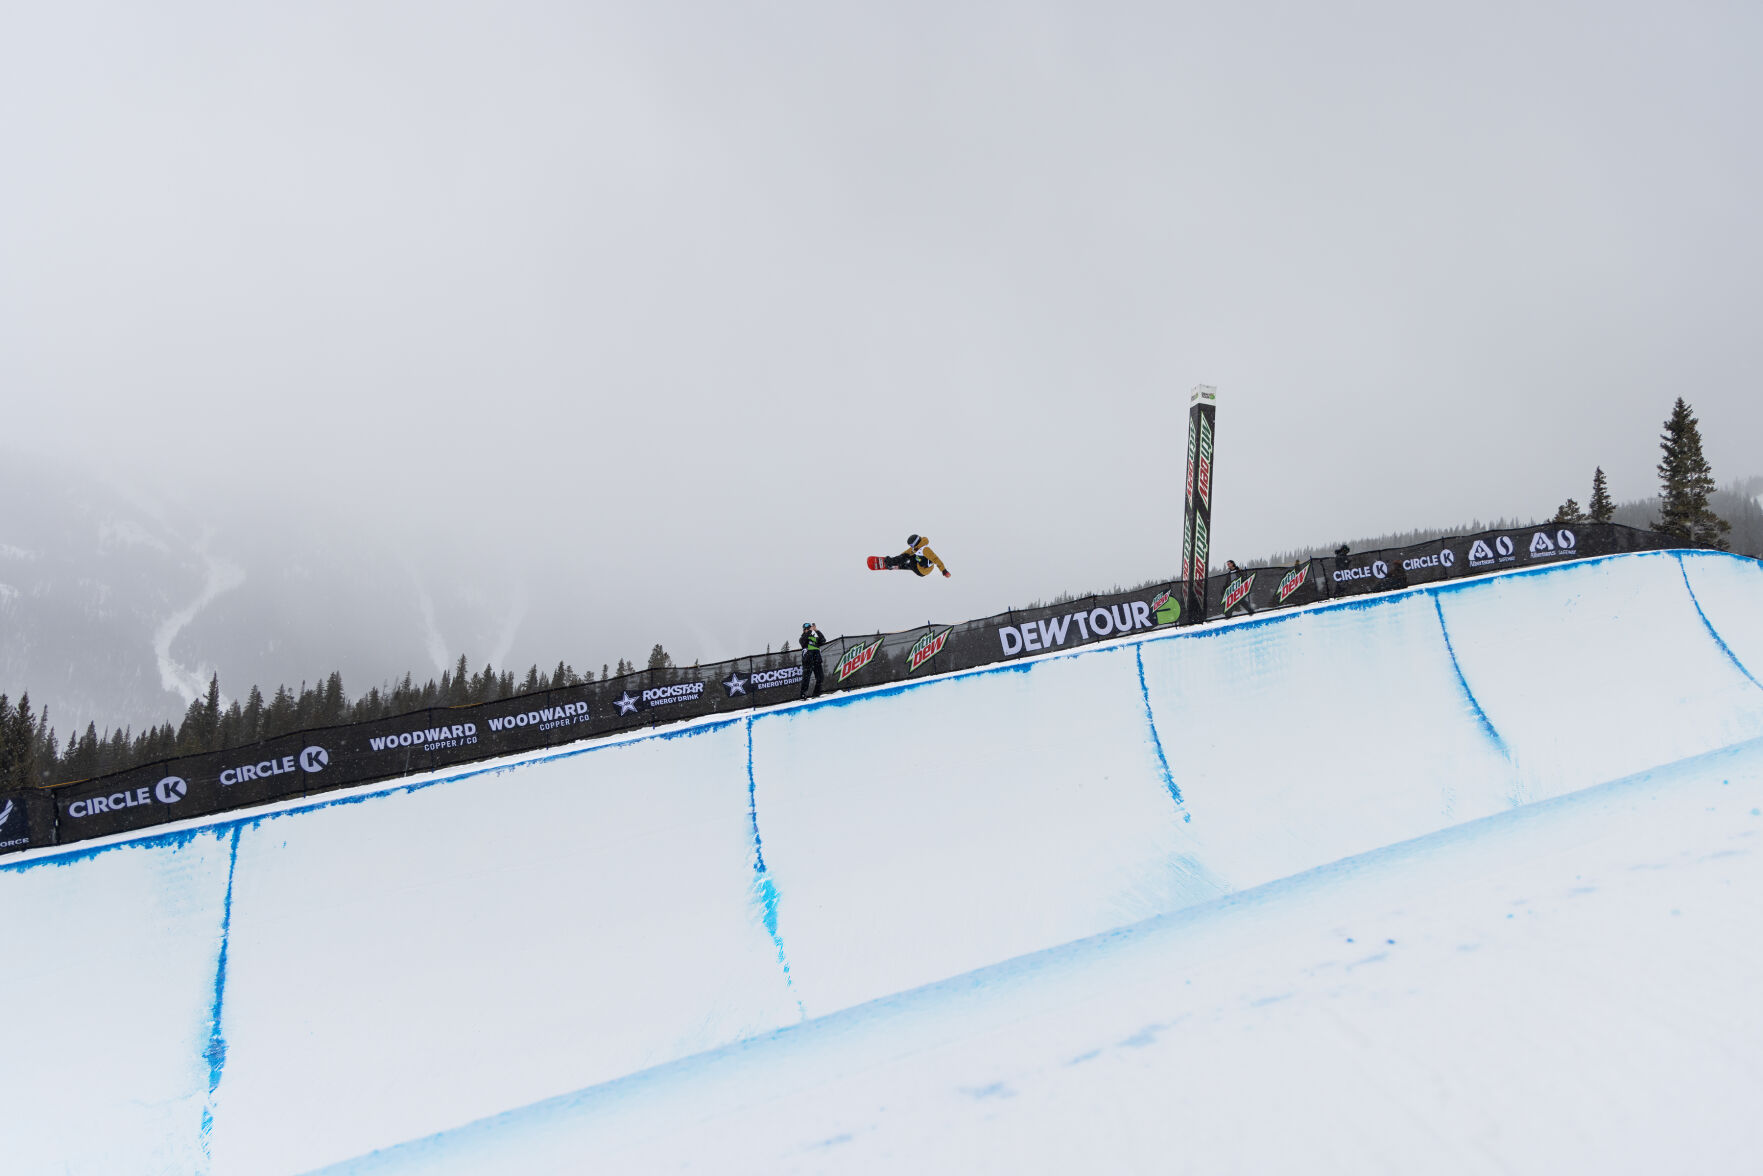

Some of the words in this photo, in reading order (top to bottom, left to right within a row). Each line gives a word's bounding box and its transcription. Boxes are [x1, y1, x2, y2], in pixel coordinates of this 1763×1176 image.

[1403, 554, 1439, 571] CIRCLE
[1442, 551, 1453, 565] K
[1333, 566, 1371, 582] CIRCLE
[1375, 562, 1387, 577] K
[642, 682, 704, 702] ROCKSTAR
[757, 680, 783, 690] ENERGY
[650, 696, 677, 707] ENERGY
[677, 693, 699, 702] DRINK
[488, 701, 588, 731] WOODWARD
[539, 717, 571, 731] COPPER
[579, 714, 590, 722] CO
[370, 723, 477, 751] WOODWARD
[424, 740, 457, 752] COPPER
[466, 736, 478, 745] CO
[219, 755, 295, 786] CIRCLE
[304, 748, 327, 770] K
[68, 787, 150, 818] CIRCLE
[161, 779, 185, 801] K
[0, 837, 30, 848] ORCE
